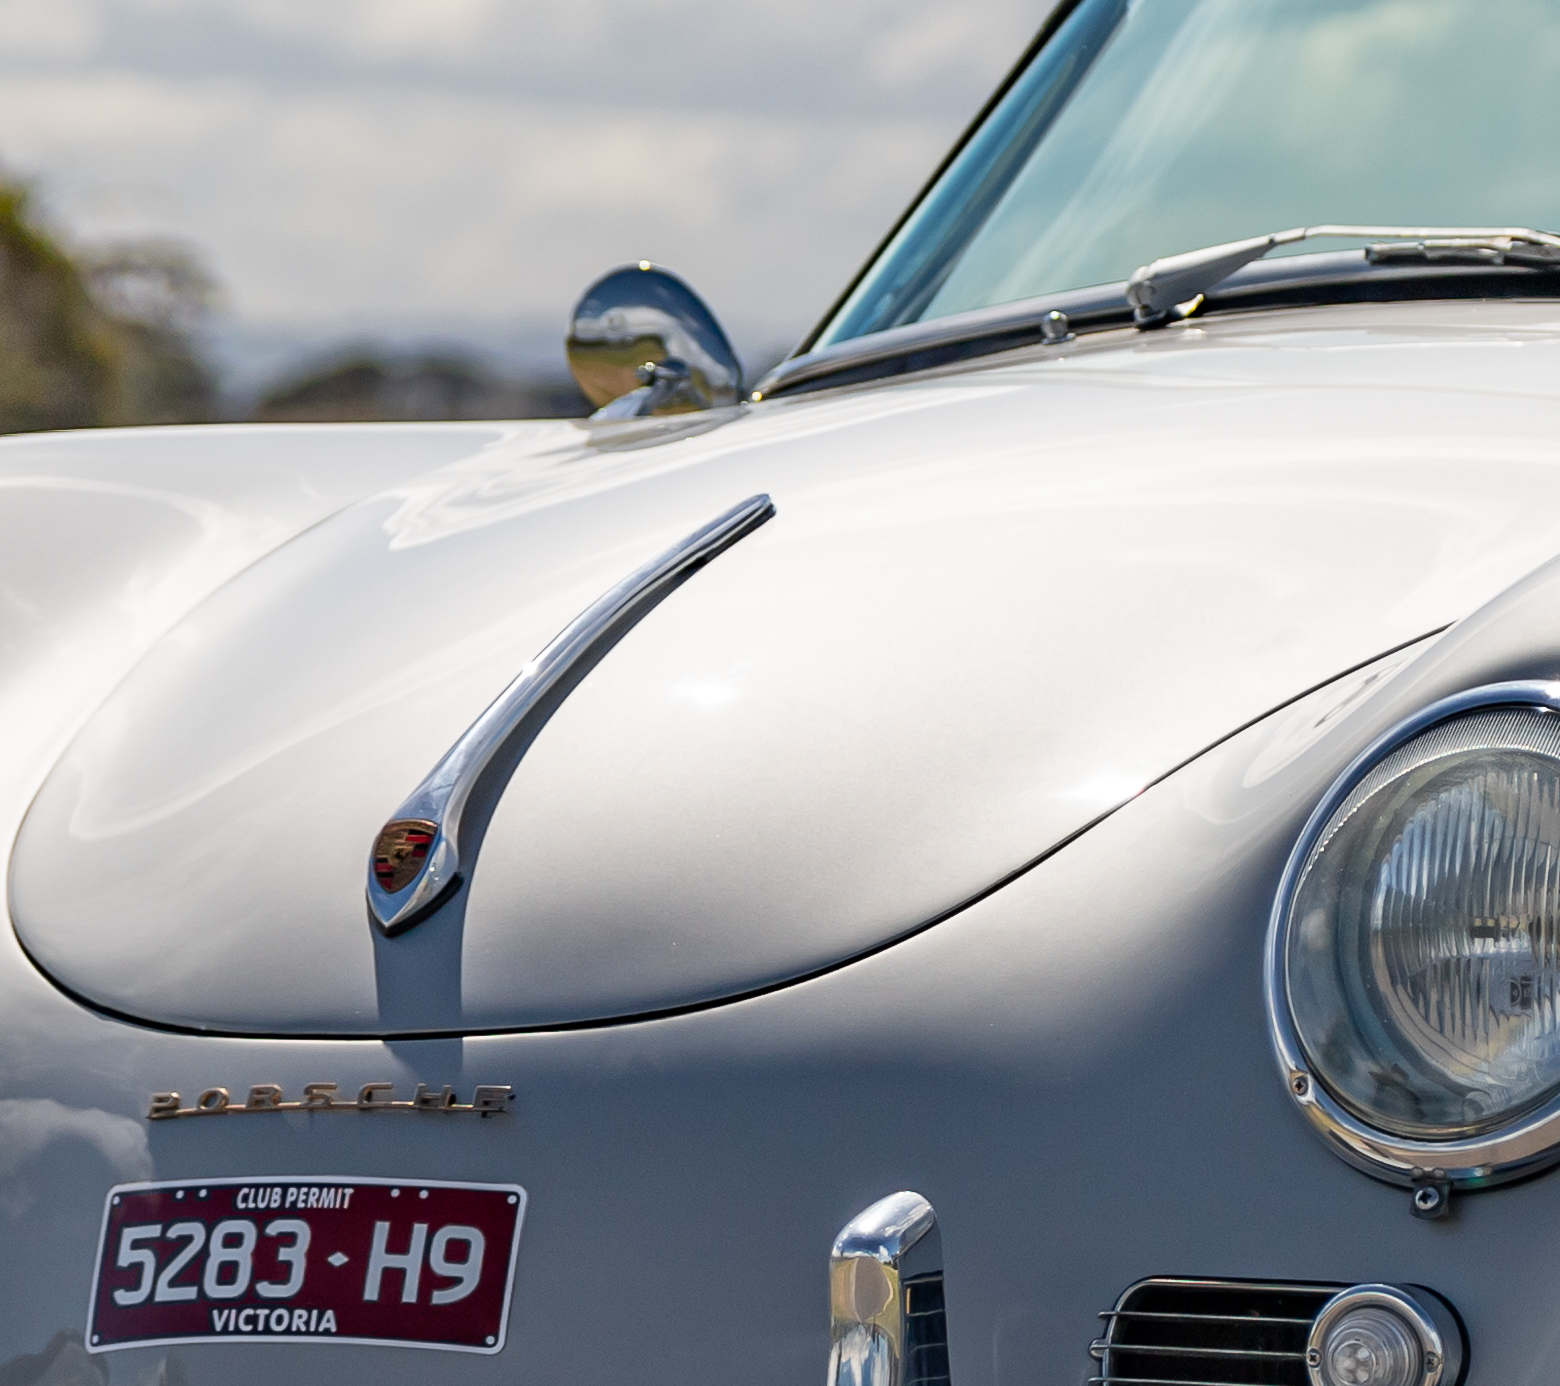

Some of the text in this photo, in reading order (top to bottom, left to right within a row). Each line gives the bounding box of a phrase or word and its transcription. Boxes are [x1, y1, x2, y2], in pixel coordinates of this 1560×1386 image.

[146, 1081, 515, 1120] PORSCHE
[237, 1187, 354, 1210] CLUB PERMIT
[113, 1219, 487, 1306] 5283 H9
[212, 1309, 337, 1334] VICTORIA
